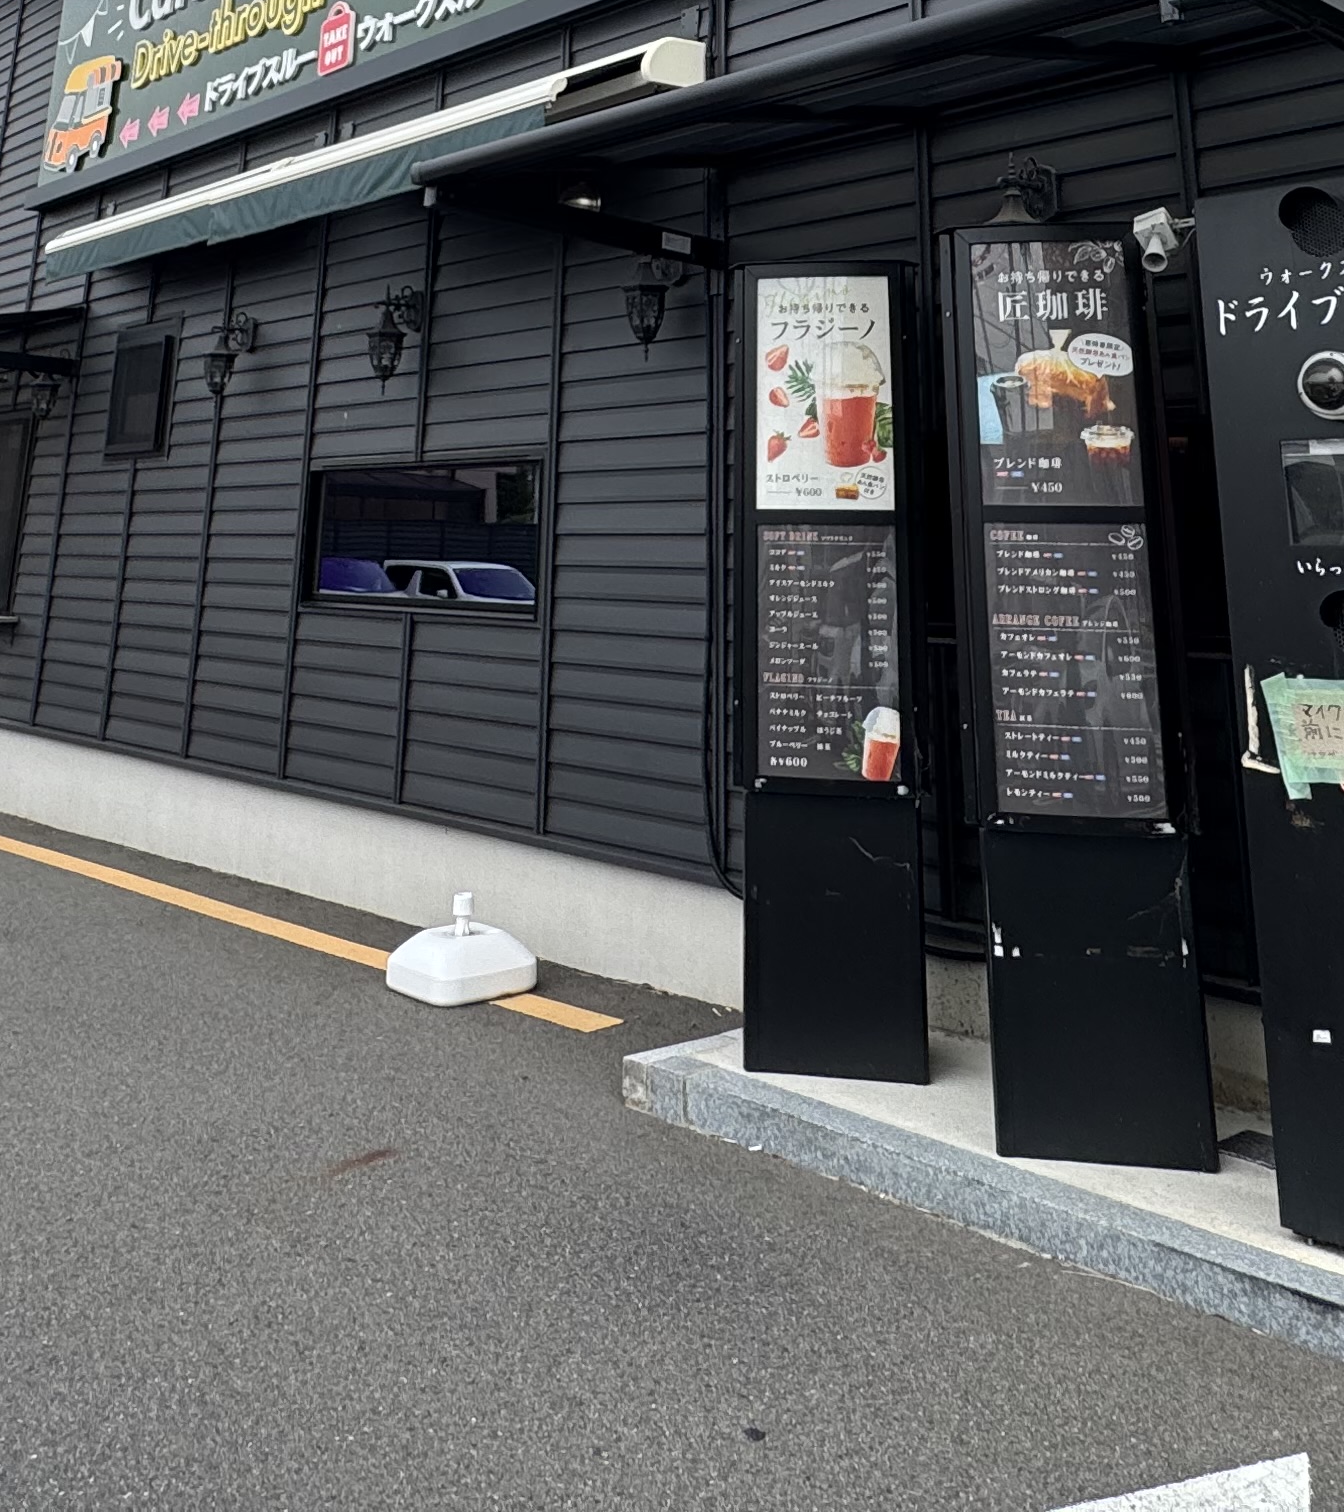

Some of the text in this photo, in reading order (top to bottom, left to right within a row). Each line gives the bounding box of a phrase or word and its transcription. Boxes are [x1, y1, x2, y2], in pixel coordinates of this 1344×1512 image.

[323, 24, 348, 43] TAKE
[324, 46, 344, 66] OUT
[204, 48, 317, 111] ドライブスルー
[997, 269, 1105, 284] お持ち帰りできる
[998, 288, 1109, 322] 匠珈琲
[771, 317, 875, 341] フラジーノ
[994, 457, 1062, 469] ブレンド珈琲
[766, 473, 819, 483] ストロベリー
[1031, 482, 1063, 493] ¥450
[996, 710, 1017, 721] TEA
